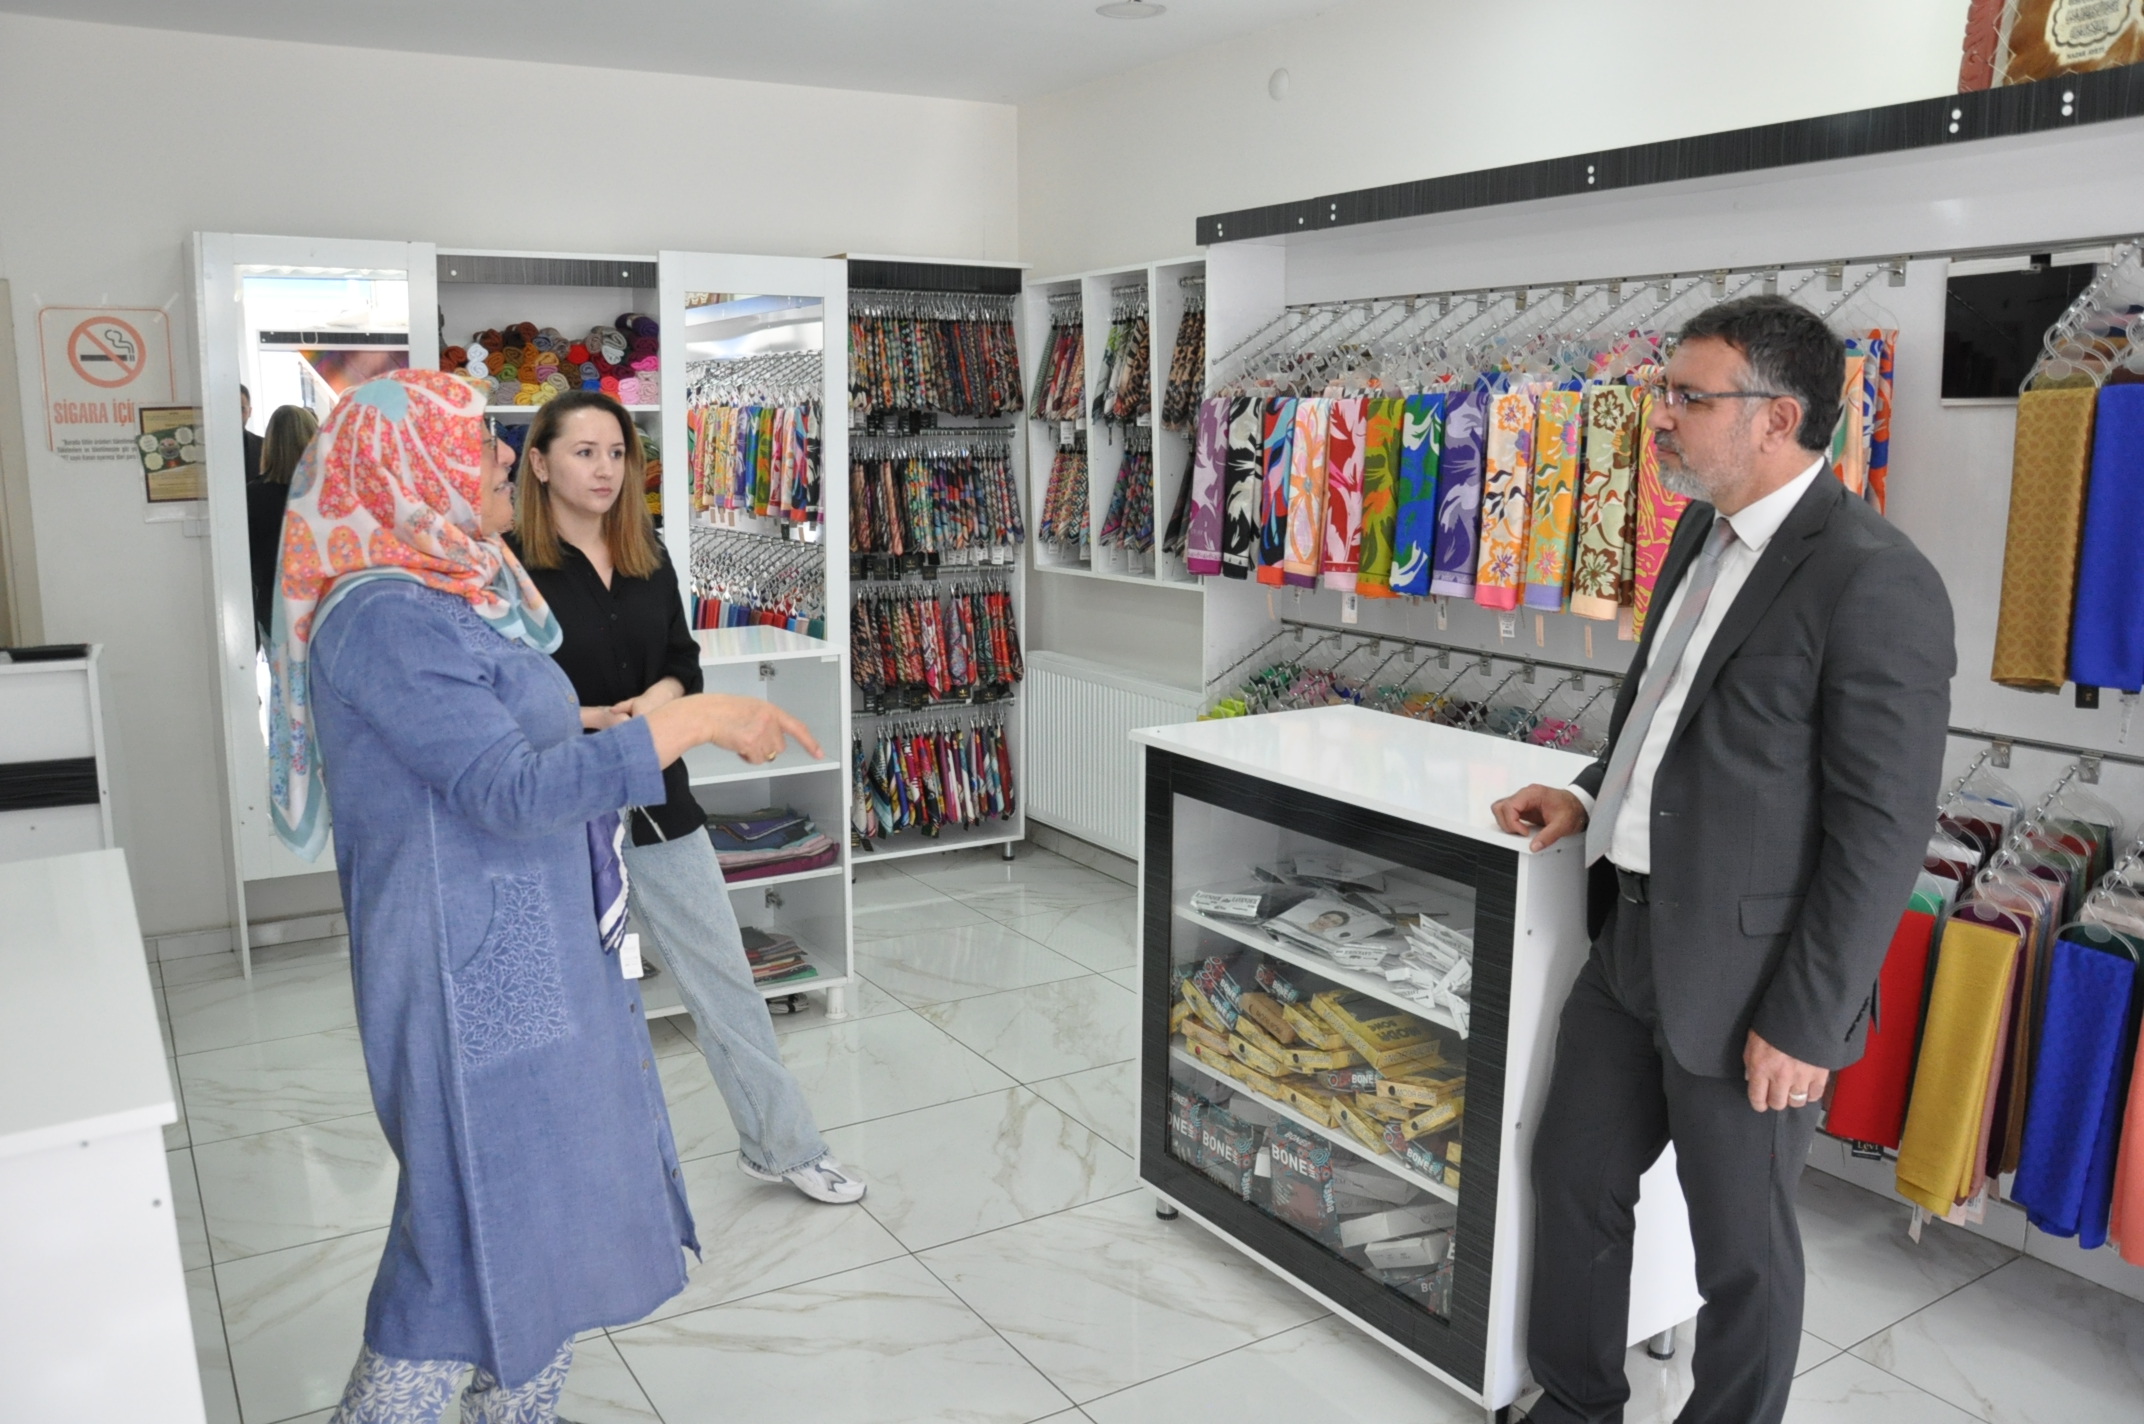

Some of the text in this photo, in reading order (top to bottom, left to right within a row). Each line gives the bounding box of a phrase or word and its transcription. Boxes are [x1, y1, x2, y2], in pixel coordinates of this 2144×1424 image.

[53, 398, 109, 424] SİGARA
[1351, 1073, 1373, 1084] BONE
[1202, 1130, 1233, 1162] BONE
[1406, 1147, 1431, 1169] BONE
[1271, 1143, 1309, 1177] BONE
